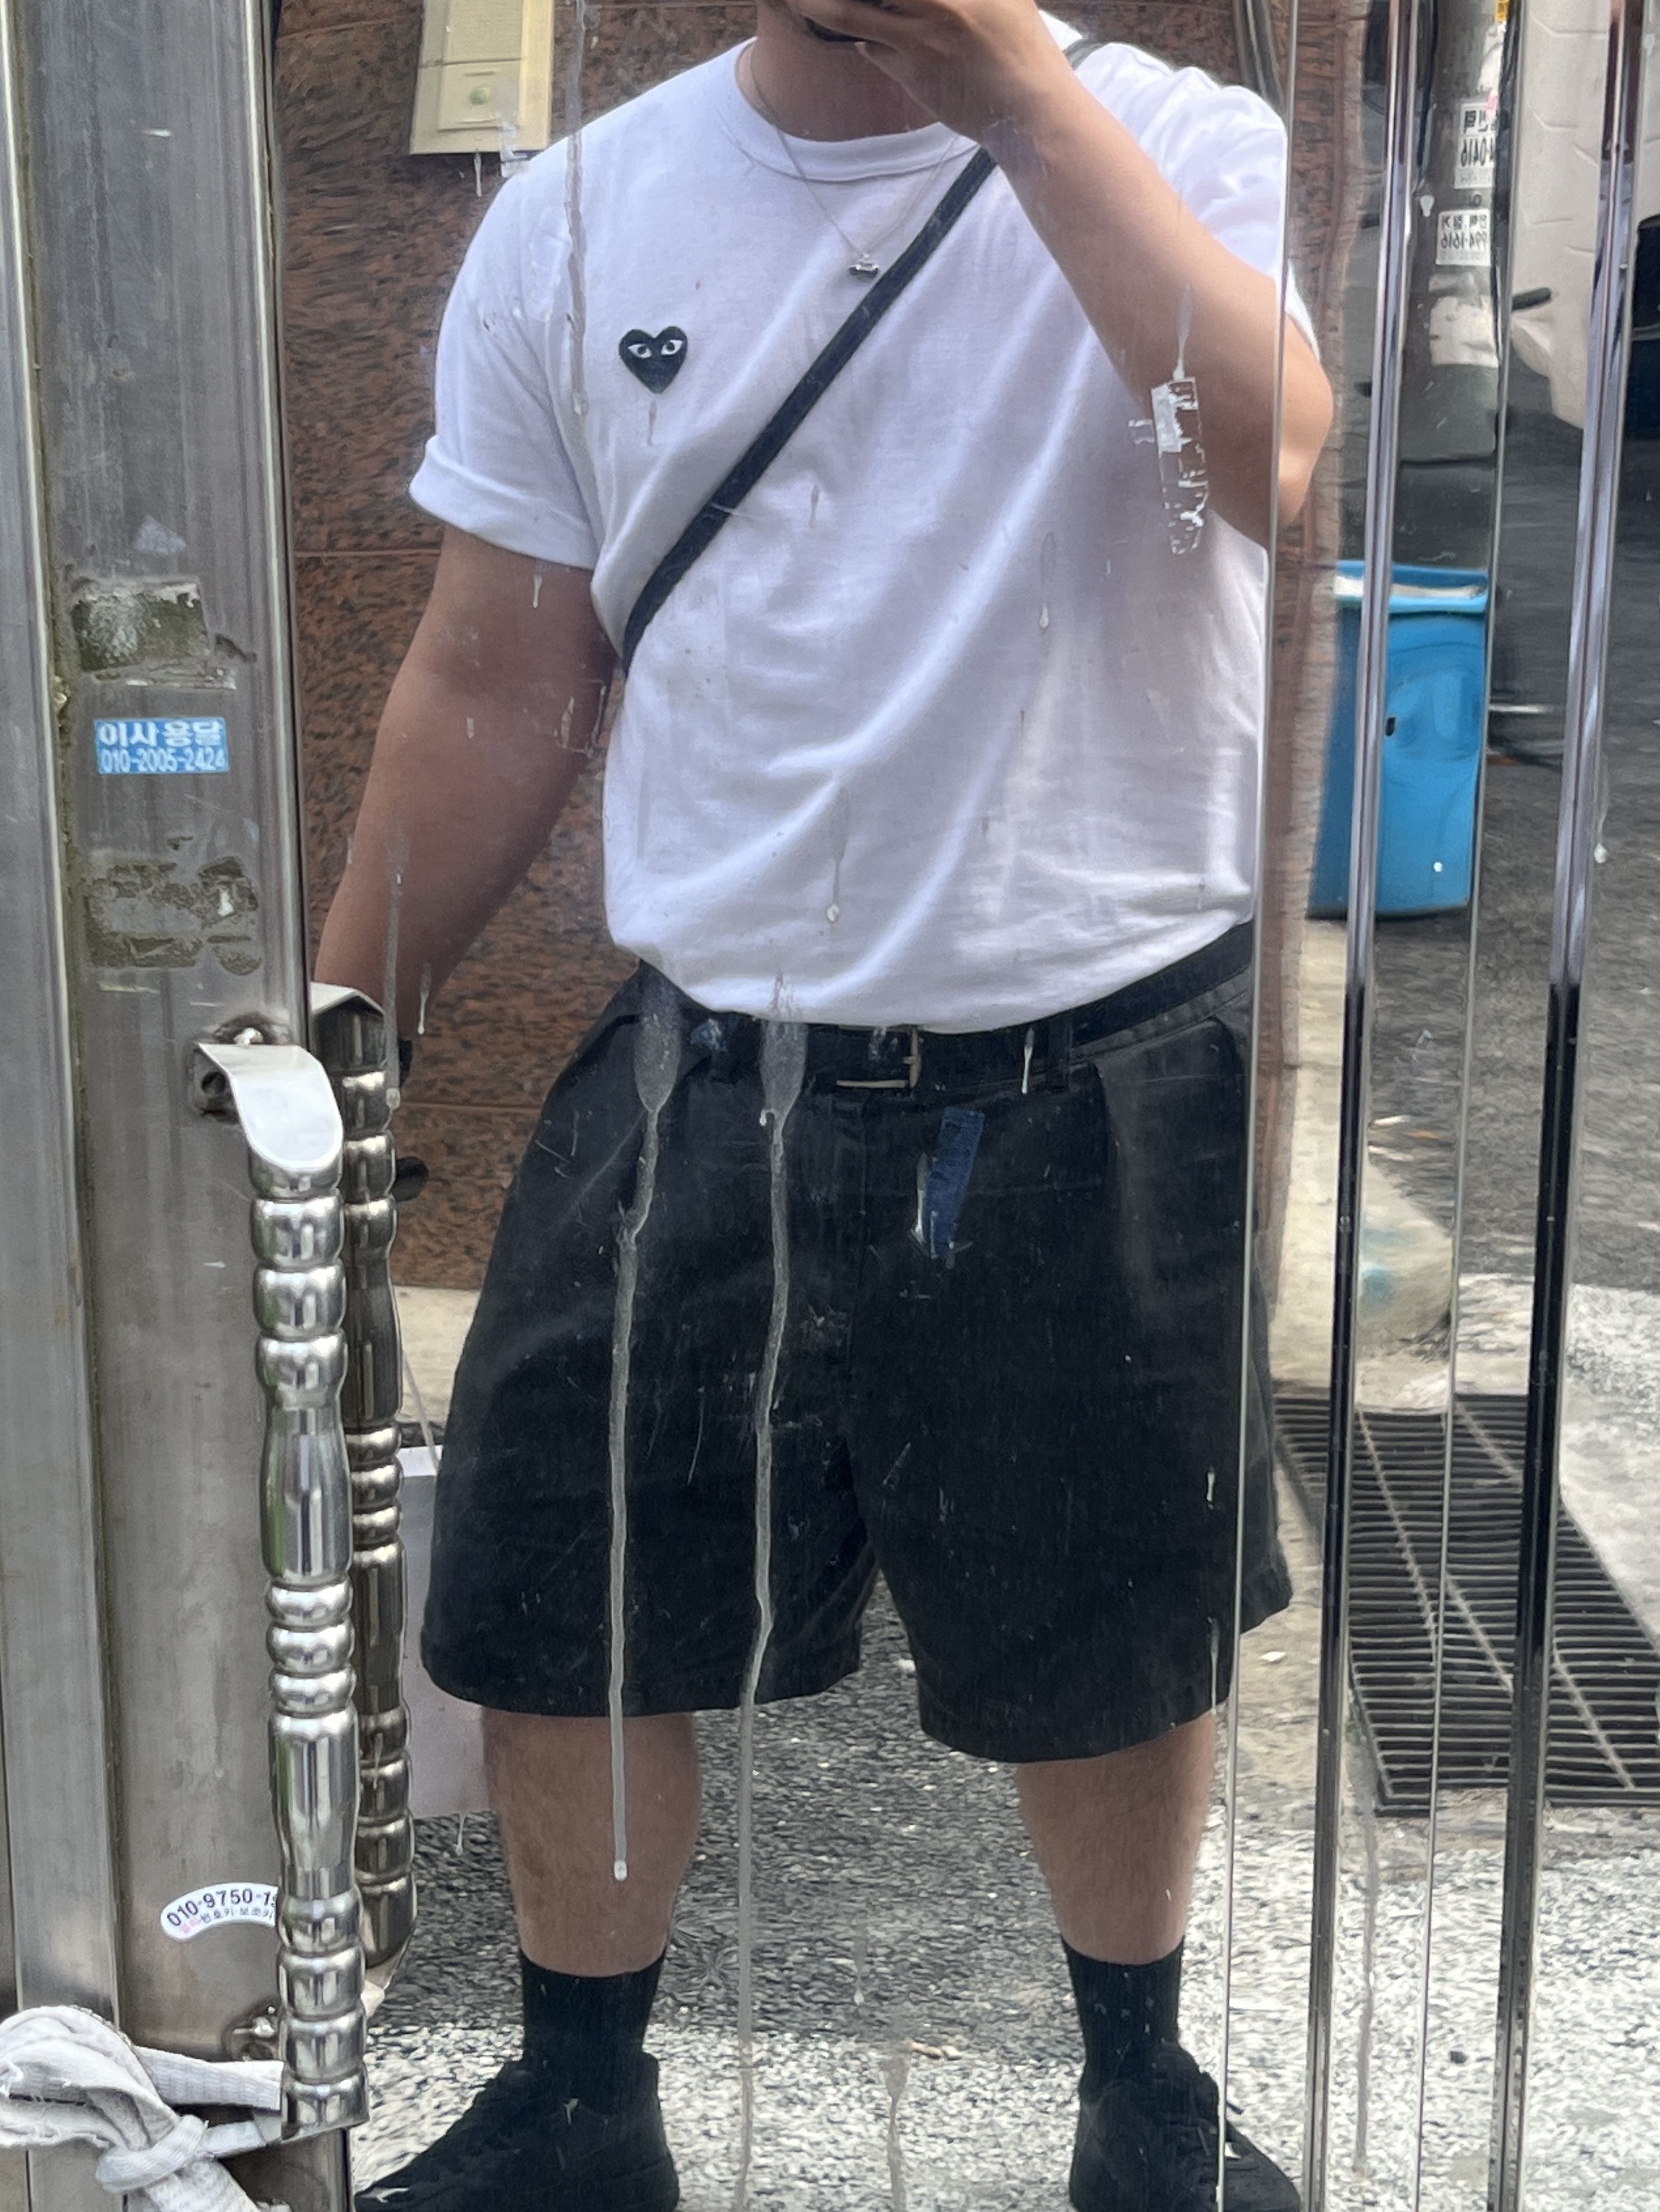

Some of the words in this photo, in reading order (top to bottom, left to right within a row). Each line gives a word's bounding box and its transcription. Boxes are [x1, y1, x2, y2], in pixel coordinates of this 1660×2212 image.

[98, 721, 159, 747] 이사
[163, 720, 223, 746] 용달
[100, 747, 226, 773] 010-2005-2424
